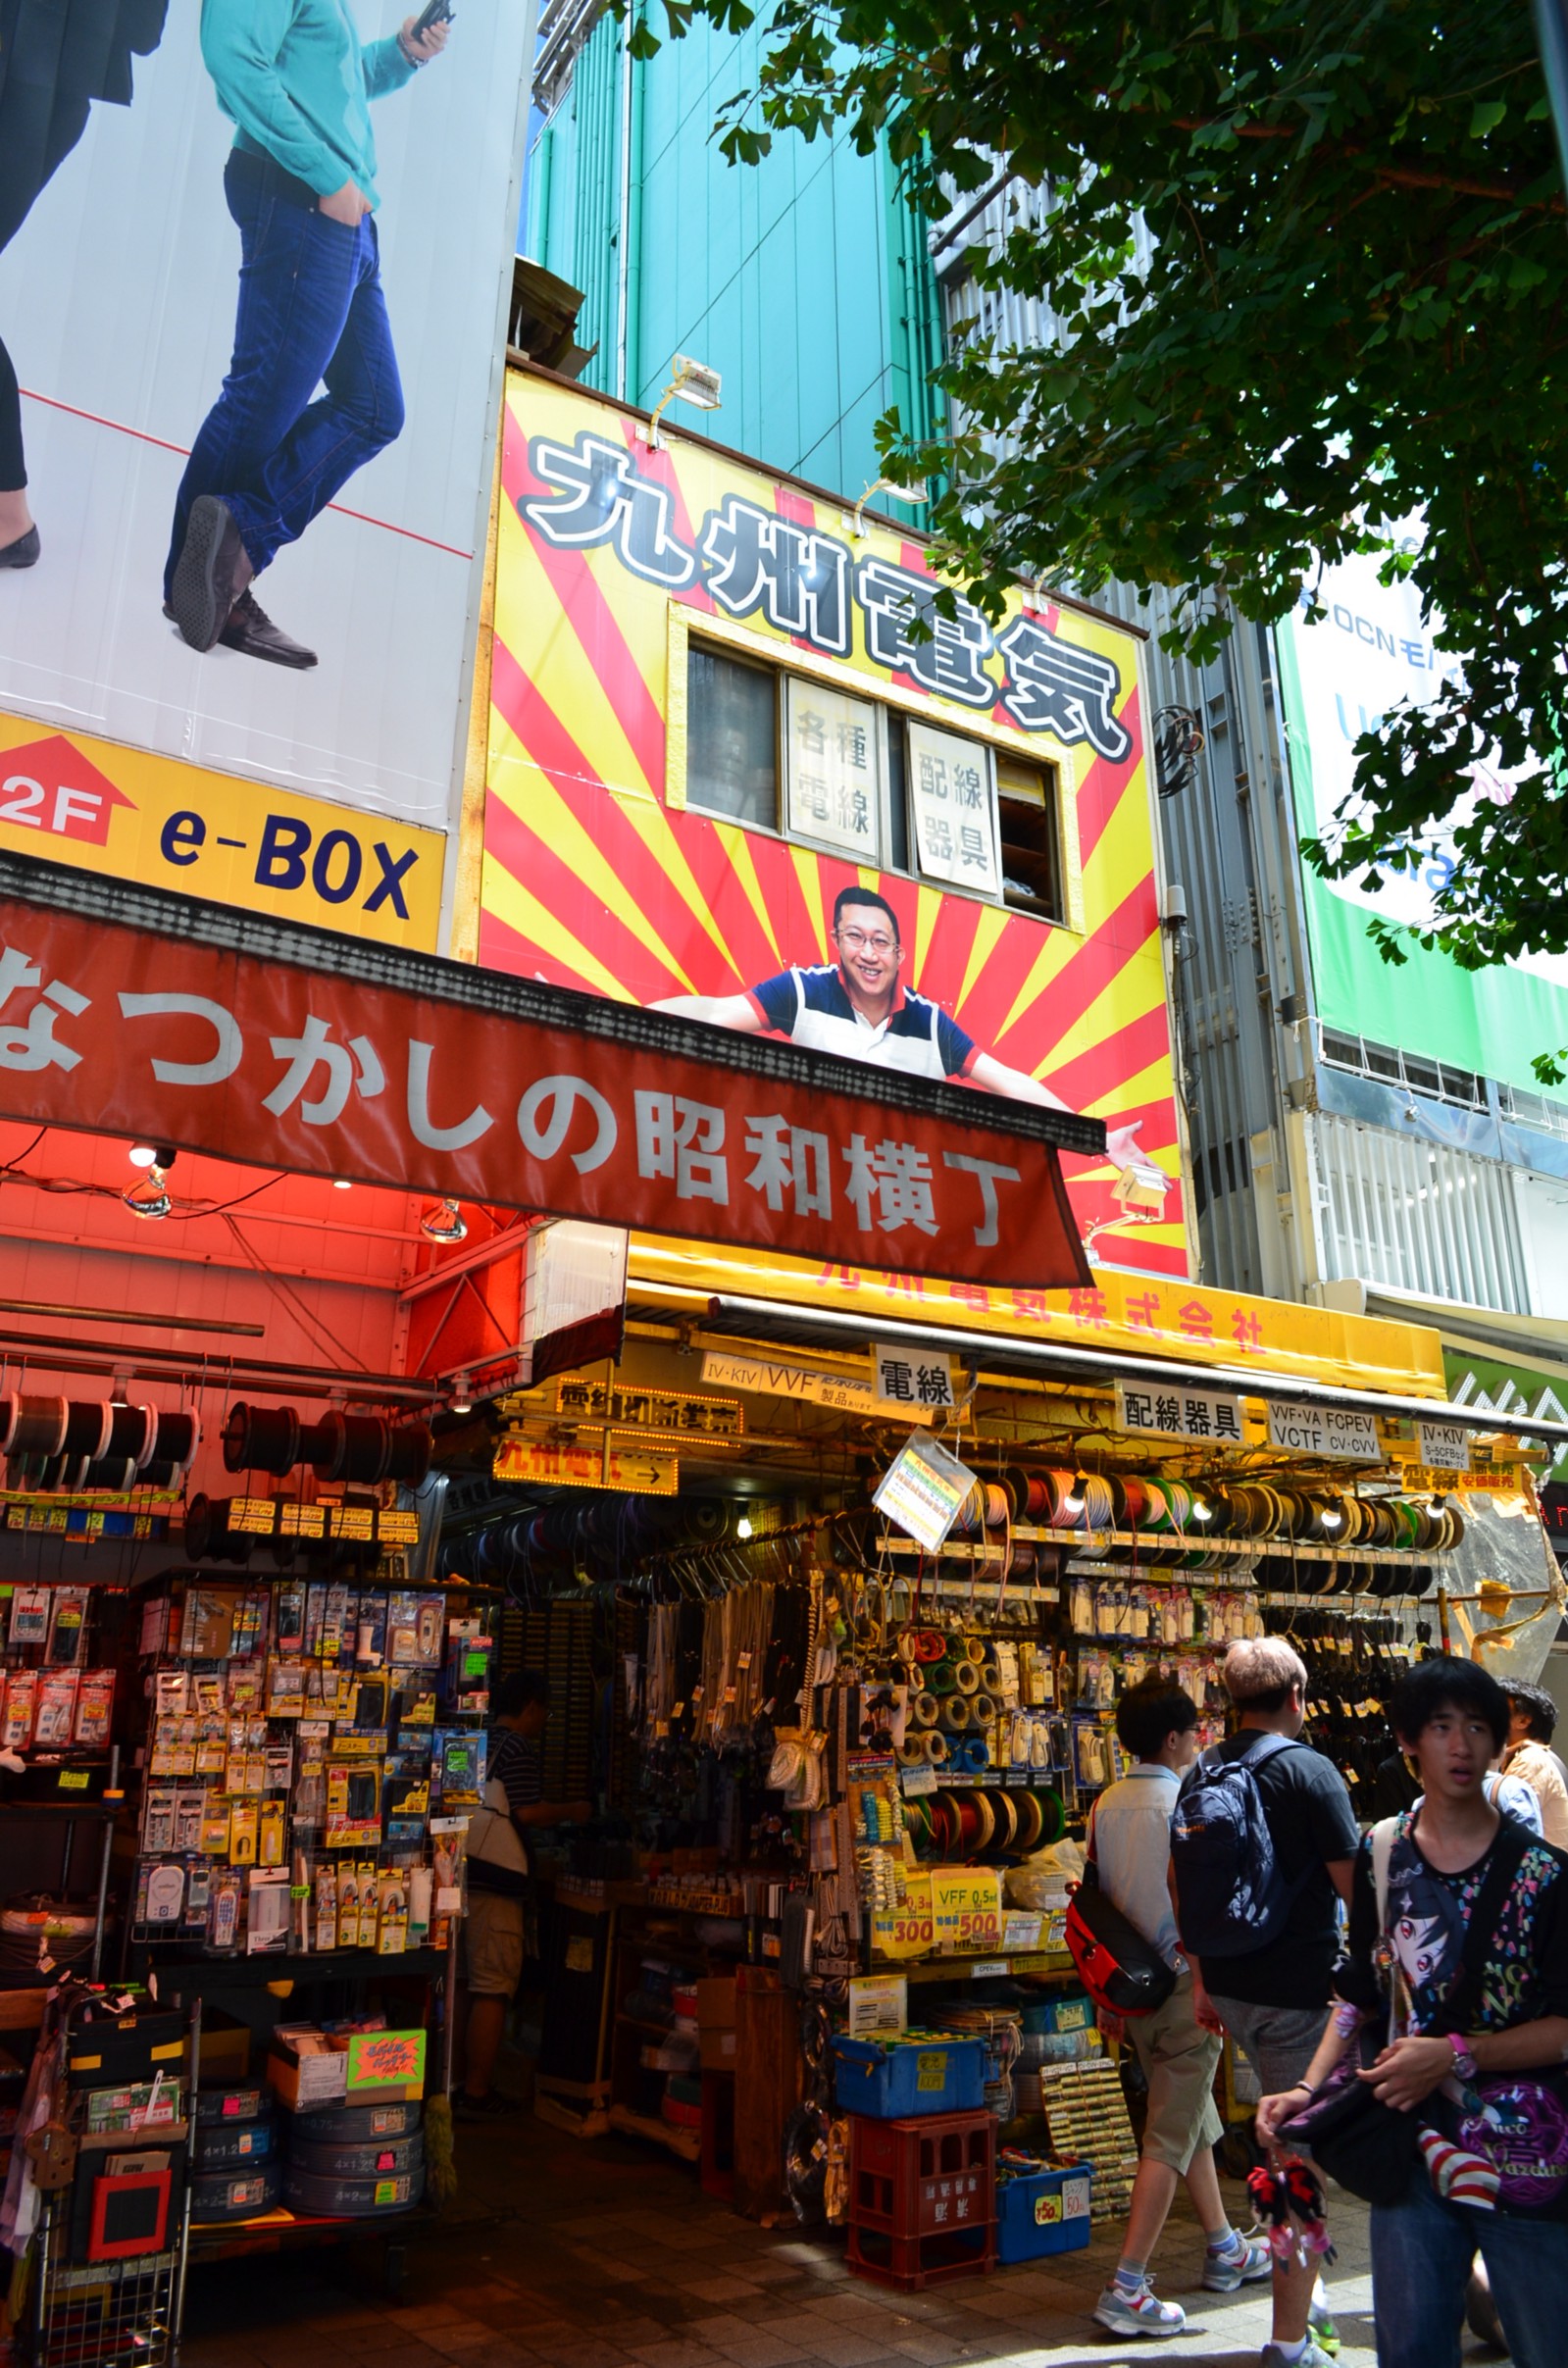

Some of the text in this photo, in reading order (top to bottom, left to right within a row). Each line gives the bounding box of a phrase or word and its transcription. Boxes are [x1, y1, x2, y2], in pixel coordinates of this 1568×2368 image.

[518, 431, 1132, 763] 九州電気
[797, 710, 868, 771] 各種
[1, 776, 102, 832] 2F
[798, 773, 869, 834] 電線
[919, 751, 984, 810] 配線
[160, 810, 420, 920] e-BOX
[925, 815, 988, 872] 器具
[0, 947, 1021, 1246] なつかしの昭和横丁
[768, 1366, 817, 1393] VVF
[881, 1360, 951, 1406] 電線
[1124, 1391, 1240, 1440] 配線器具
[1274, 1425, 1323, 1450] VCTF
[1326, 1411, 1373, 1434] FCPEV
[938, 1889, 968, 1905] VFF
